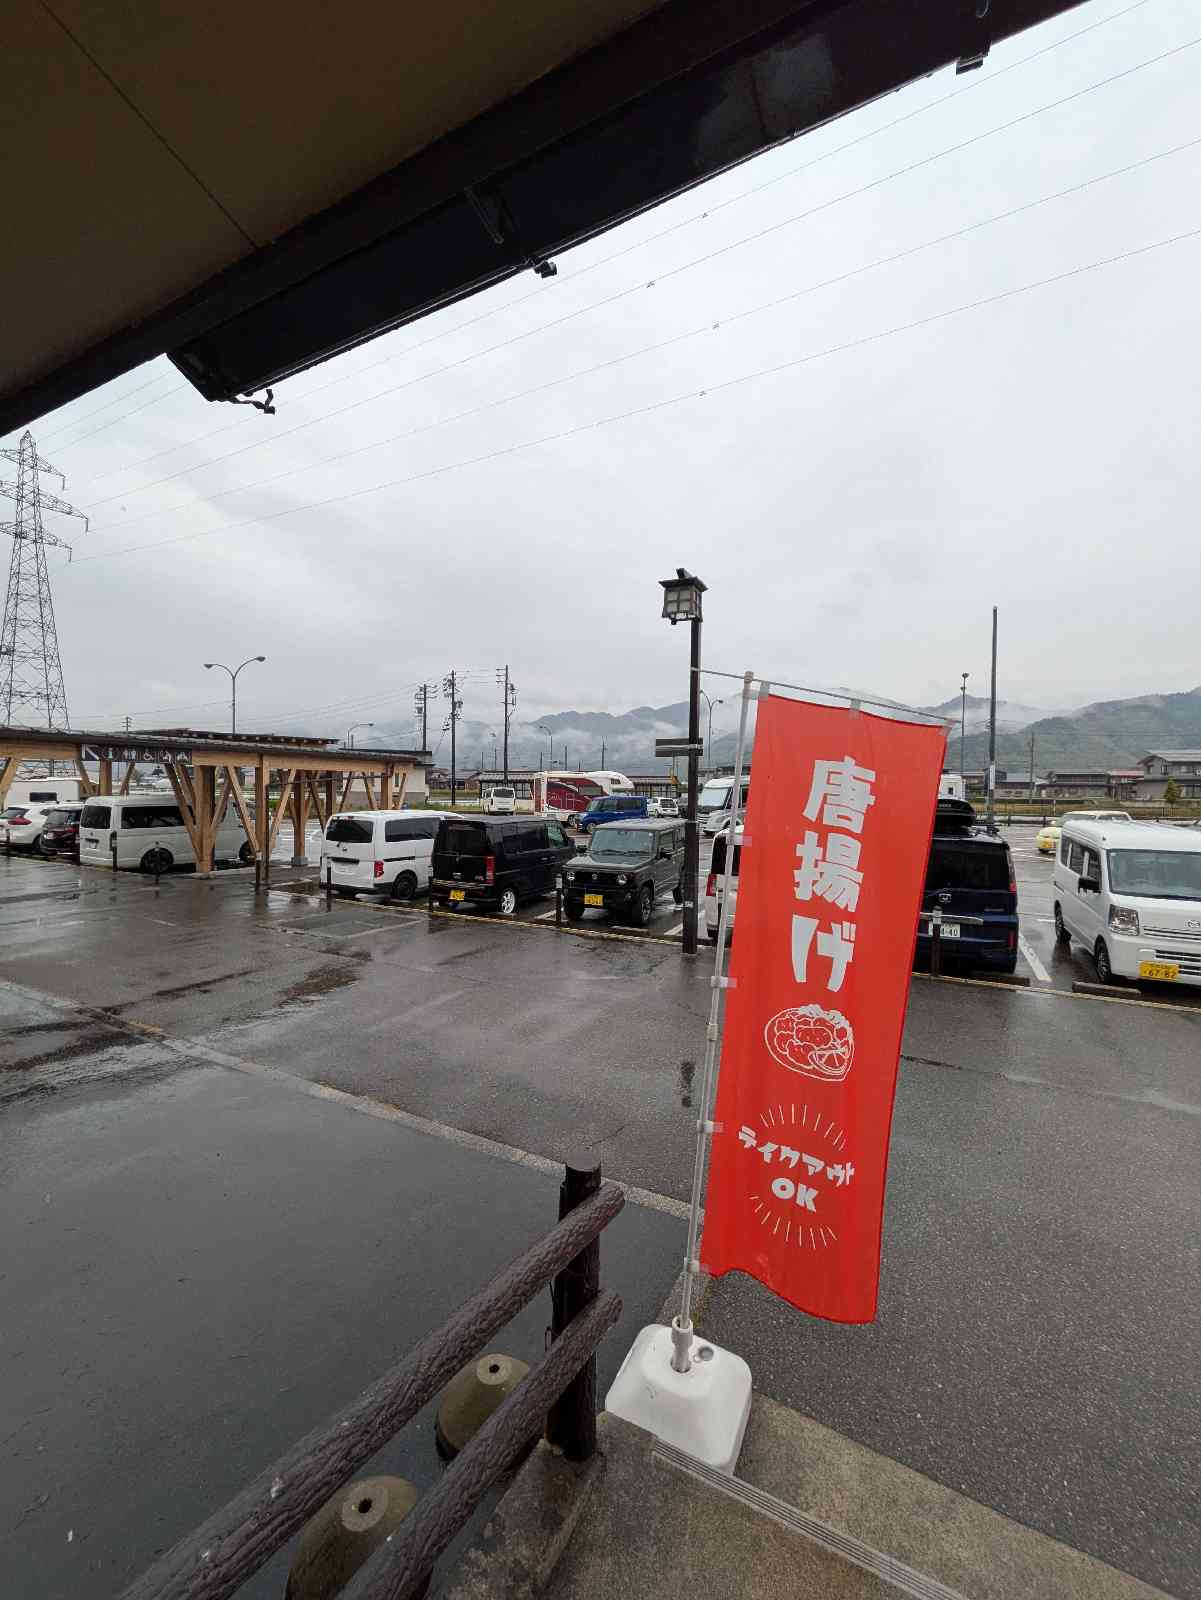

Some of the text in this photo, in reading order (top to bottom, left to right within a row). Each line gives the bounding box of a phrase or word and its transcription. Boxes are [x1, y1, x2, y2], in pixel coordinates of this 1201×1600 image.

[791, 755, 876, 993] 唐揚げ
[738, 1125, 855, 1188] テイクアウト
[771, 1177, 819, 1213] OK
